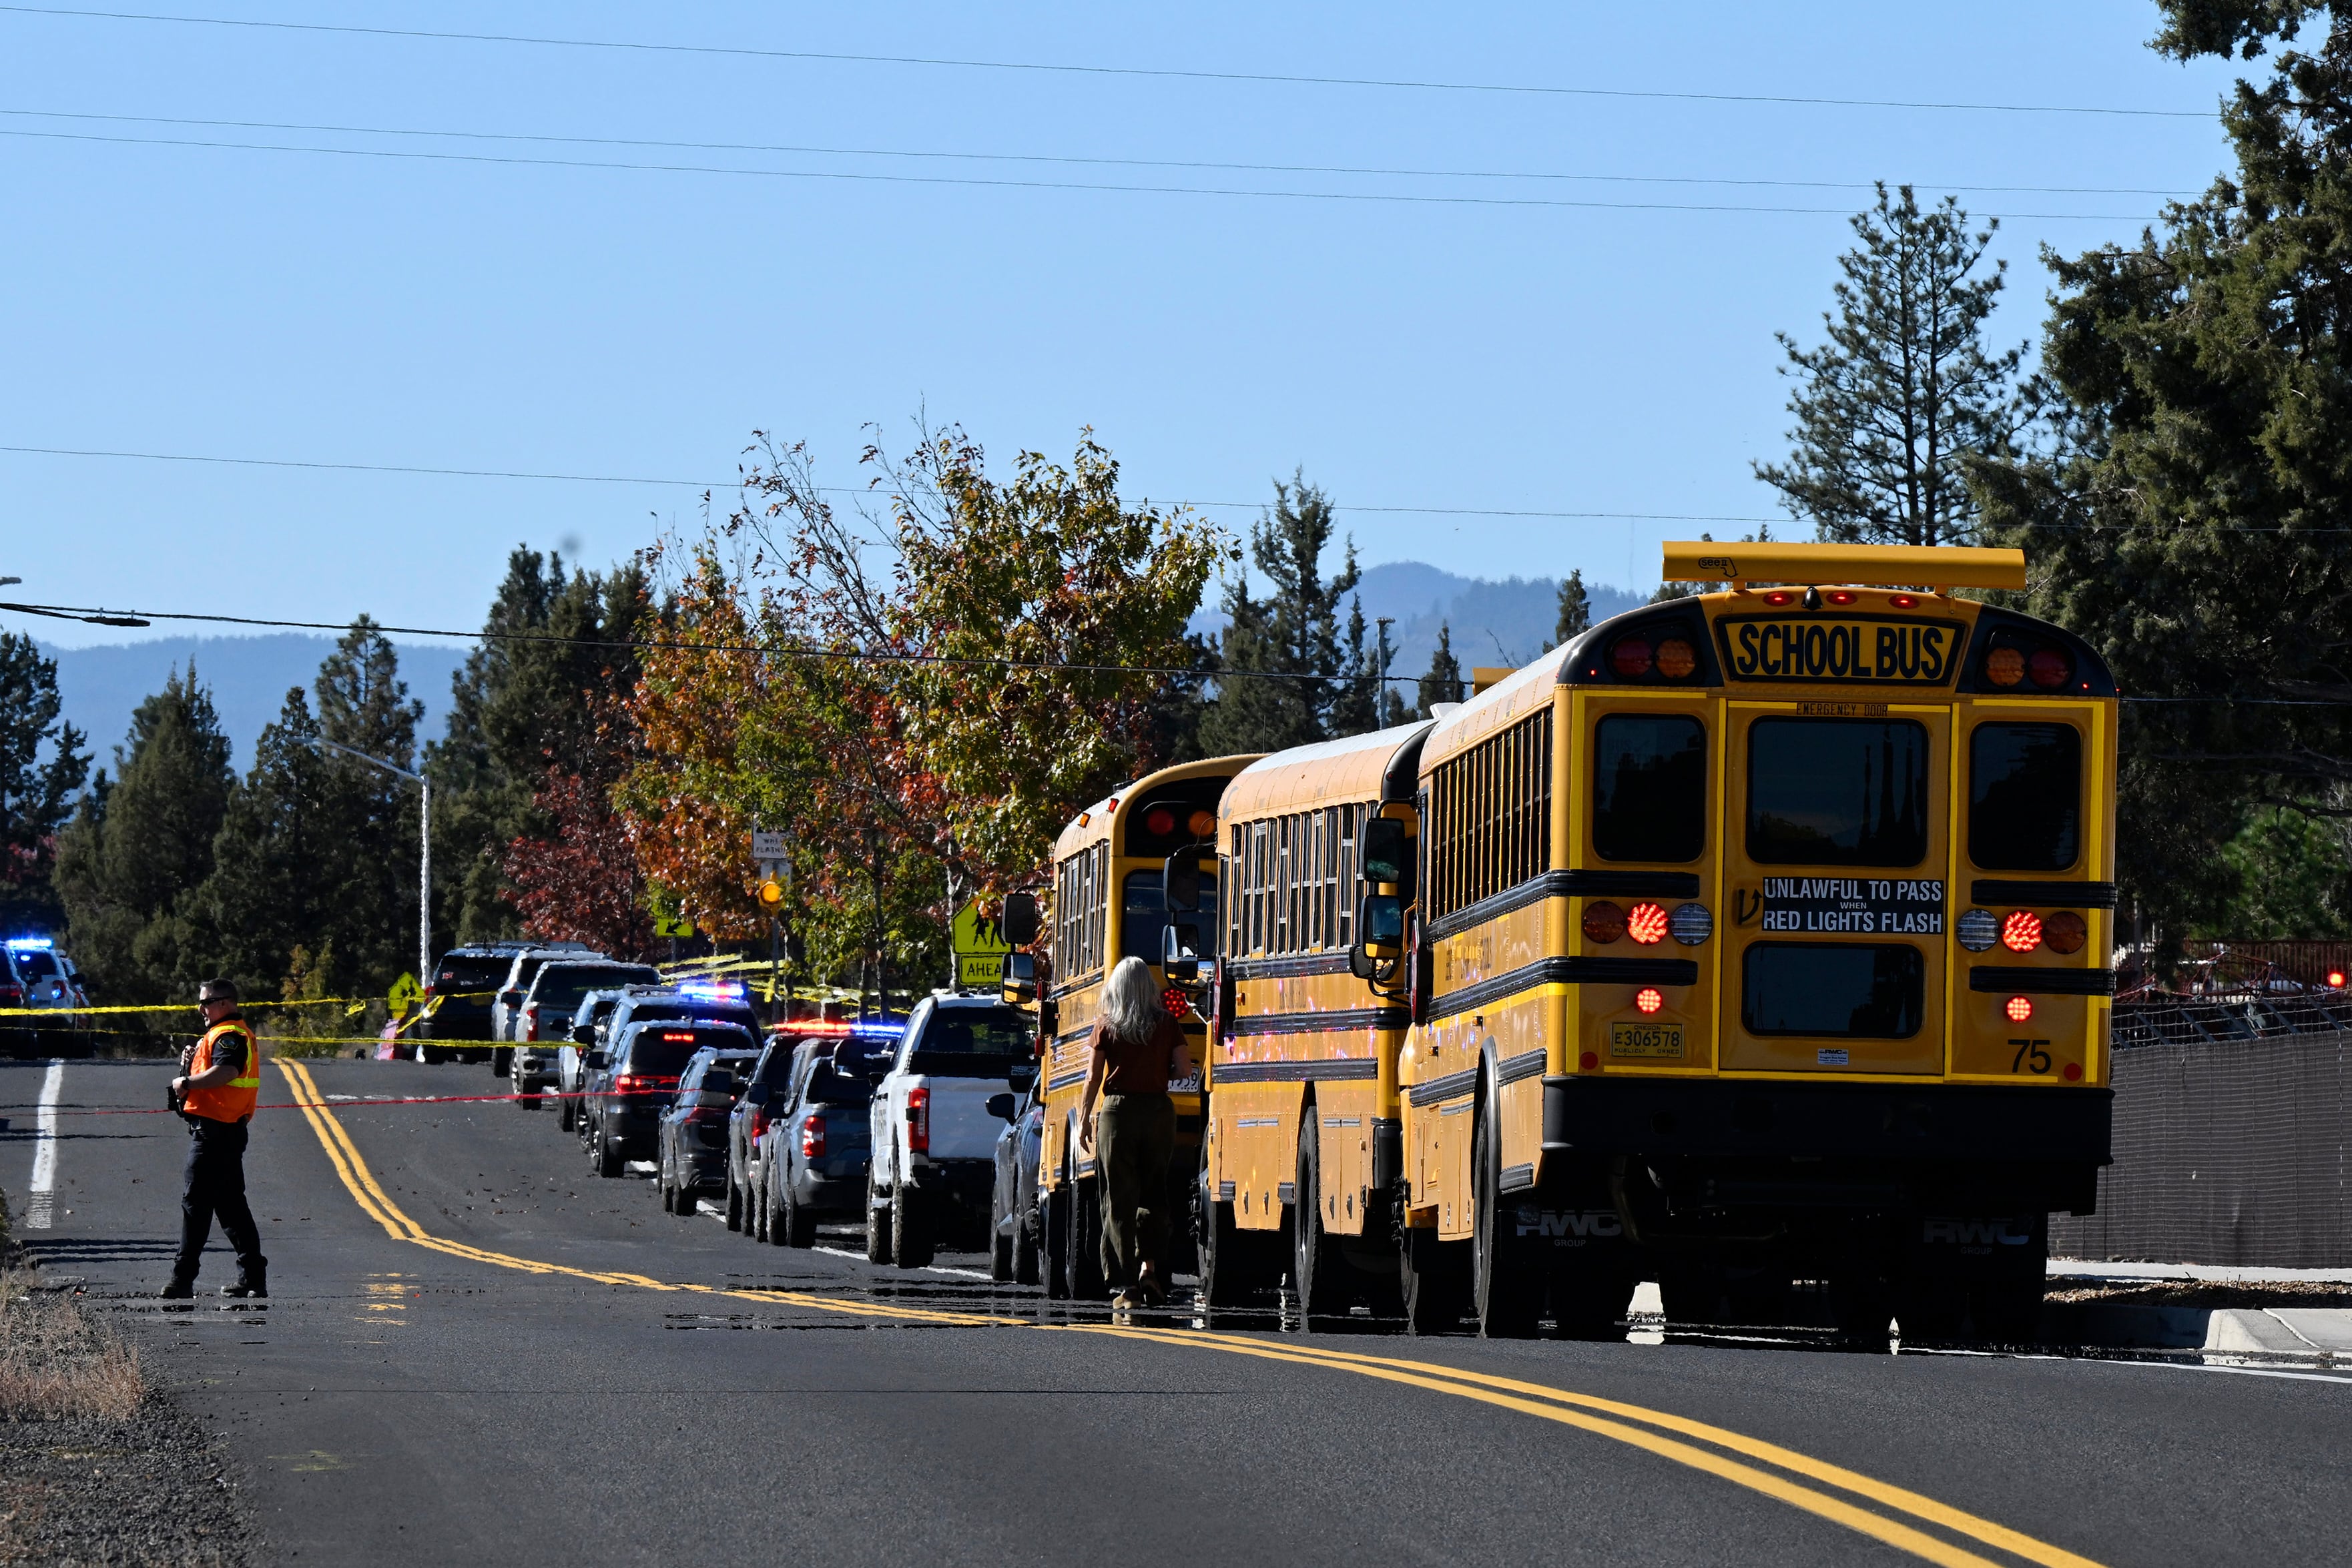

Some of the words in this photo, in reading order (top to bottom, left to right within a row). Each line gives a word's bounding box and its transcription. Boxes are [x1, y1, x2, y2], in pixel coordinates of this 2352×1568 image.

[1701, 558, 1720, 566] see
[1737, 623, 1871, 677] SCHOOL
[1875, 626, 1944, 679] BUS
[1796, 703, 1857, 716] EMERGENCY
[1864, 704, 1888, 717] DOOR
[1764, 878, 1863, 899] UNLAWFUL
[1868, 880, 1891, 901] TO
[1896, 880, 1942, 901] PASS
[1839, 901, 1867, 909] WHEN
[1763, 910, 1801, 930] RED
[1807, 911, 1875, 931] LIGHTS
[1881, 912, 1942, 933] FLASH
[966, 962, 1001, 977] AHEA
[1614, 1030, 1680, 1047] E306578
[2007, 1039, 2052, 1074] 75
[1554, 1239, 1586, 1247] GROUP
[1960, 1246, 1992, 1255] GROUP
